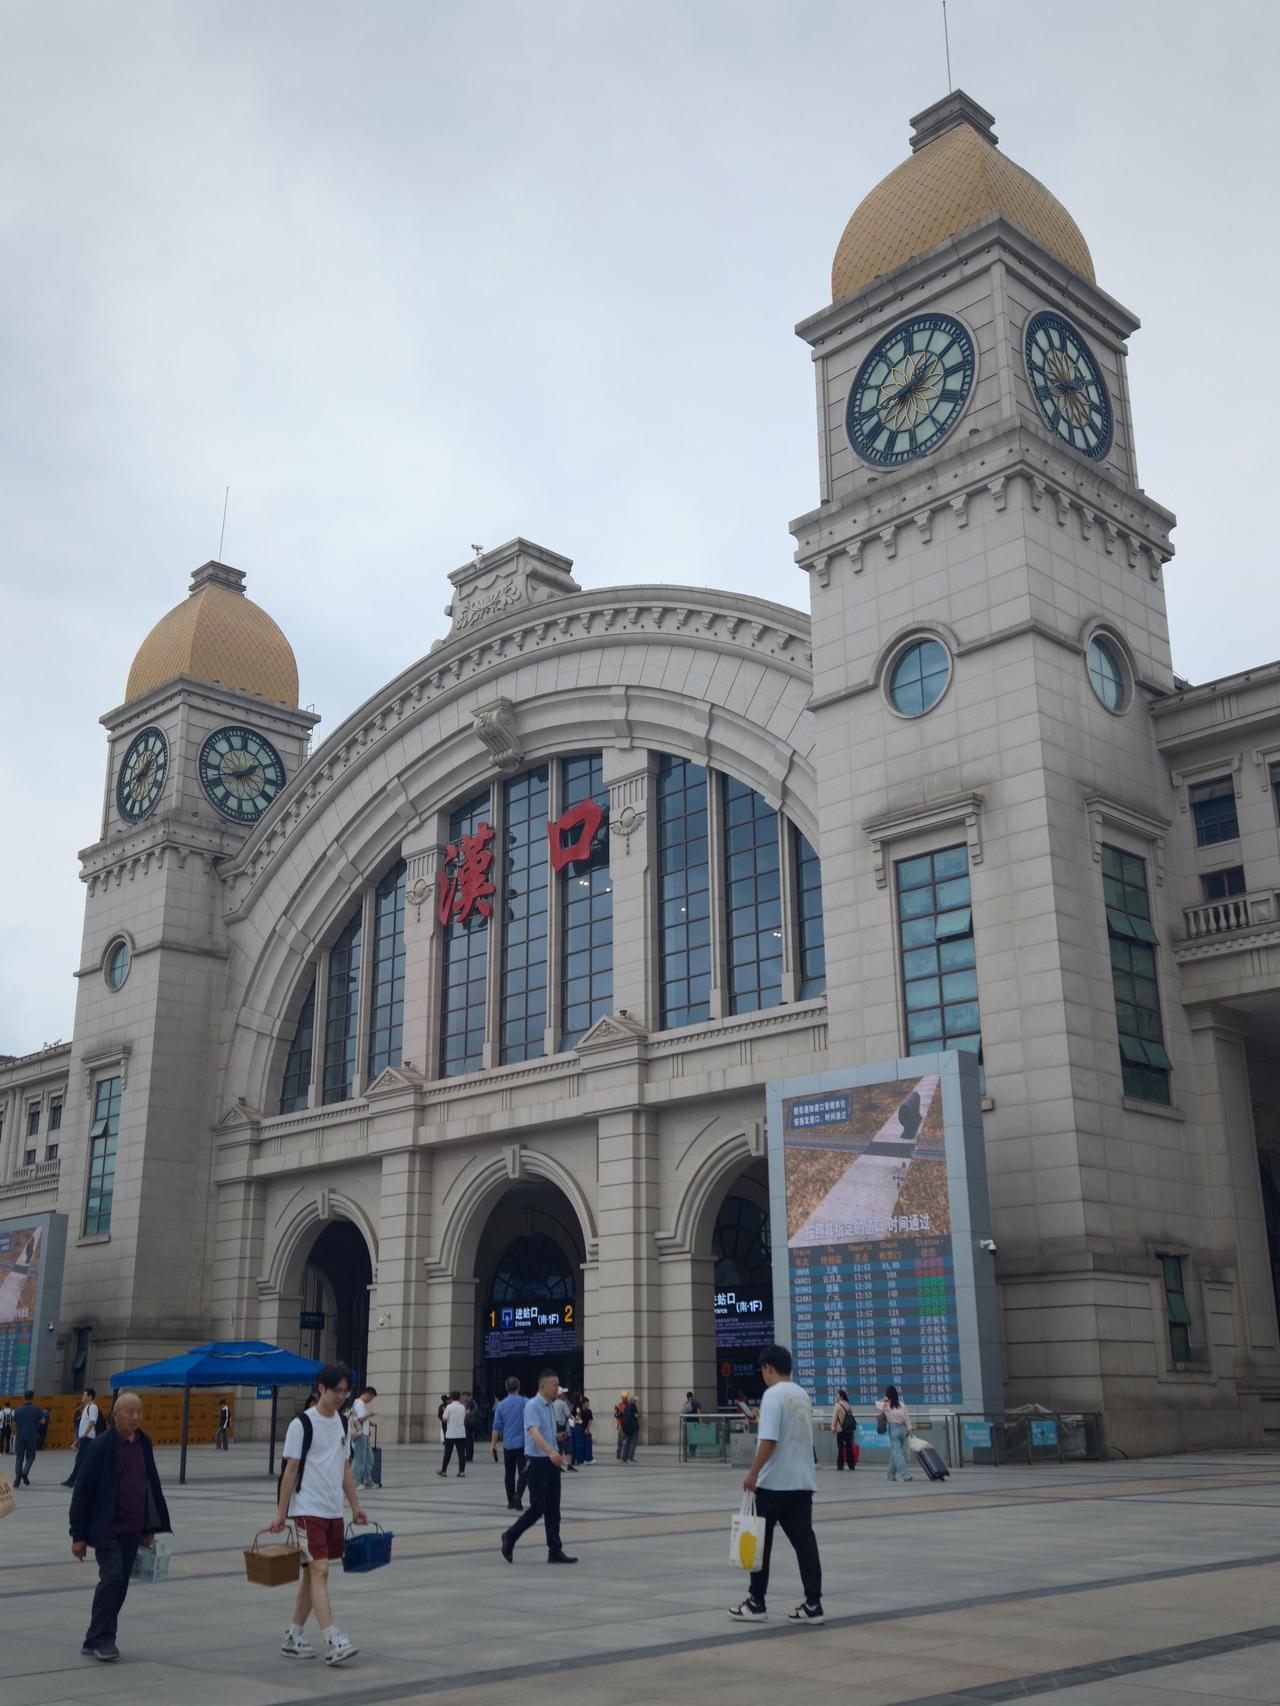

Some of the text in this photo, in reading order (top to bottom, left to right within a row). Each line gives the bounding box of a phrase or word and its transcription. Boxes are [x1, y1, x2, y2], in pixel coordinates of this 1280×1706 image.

[888, 1214, 929, 1232] 时间通过
[826, 1293, 839, 1301] 广元
[515, 1307, 538, 1319] 进站口
[565, 1305, 573, 1322] 2
[490, 1310, 495, 1327] 1
[920, 1325, 947, 1334] 正在候车
[920, 1336, 947, 1344] 正在候车
[921, 1345, 948, 1354] 正在候车
[922, 1355, 948, 1363] 正在候车
[922, 1365, 949, 1373] 正在候车
[923, 1375, 950, 1383] 正在候车
[923, 1385, 950, 1393] 正在候车
